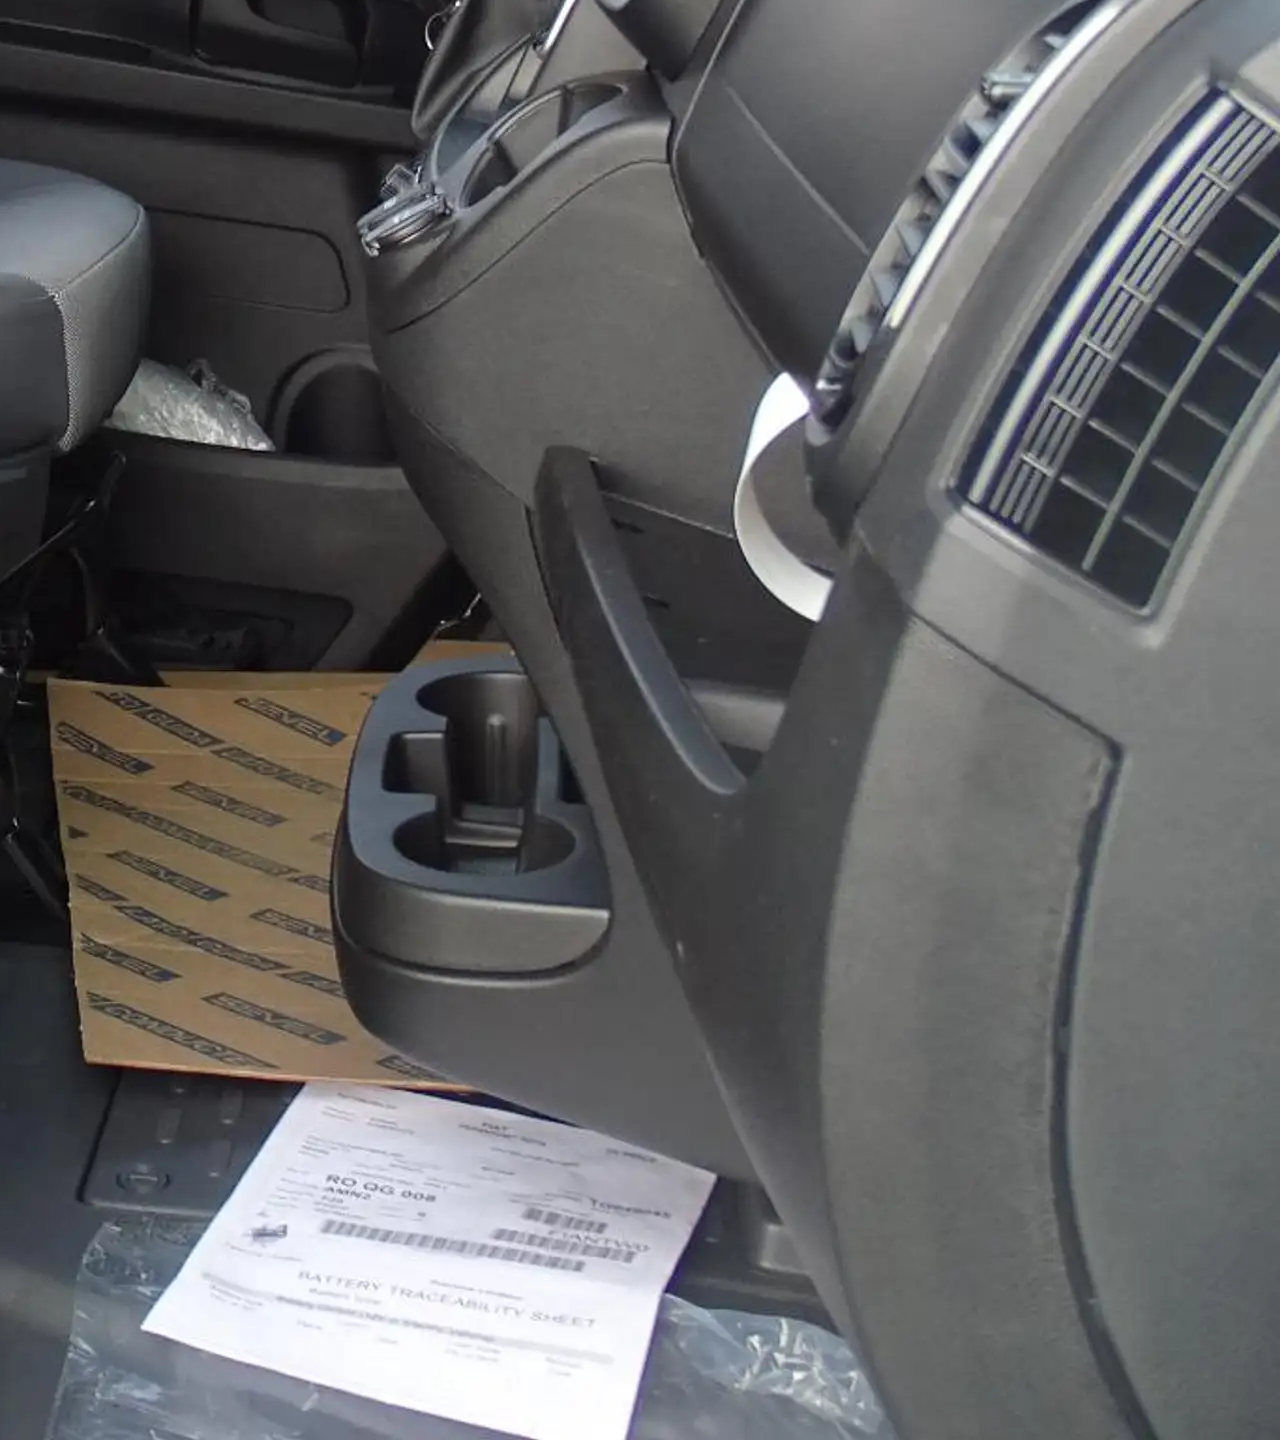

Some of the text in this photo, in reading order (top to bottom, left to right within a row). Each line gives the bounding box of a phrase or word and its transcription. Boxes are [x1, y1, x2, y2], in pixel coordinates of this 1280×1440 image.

[297, 1270, 382, 1291] BATTERY
[389, 1284, 527, 1319] TRACEABILITY
[529, 1311, 597, 1329] SHEET
